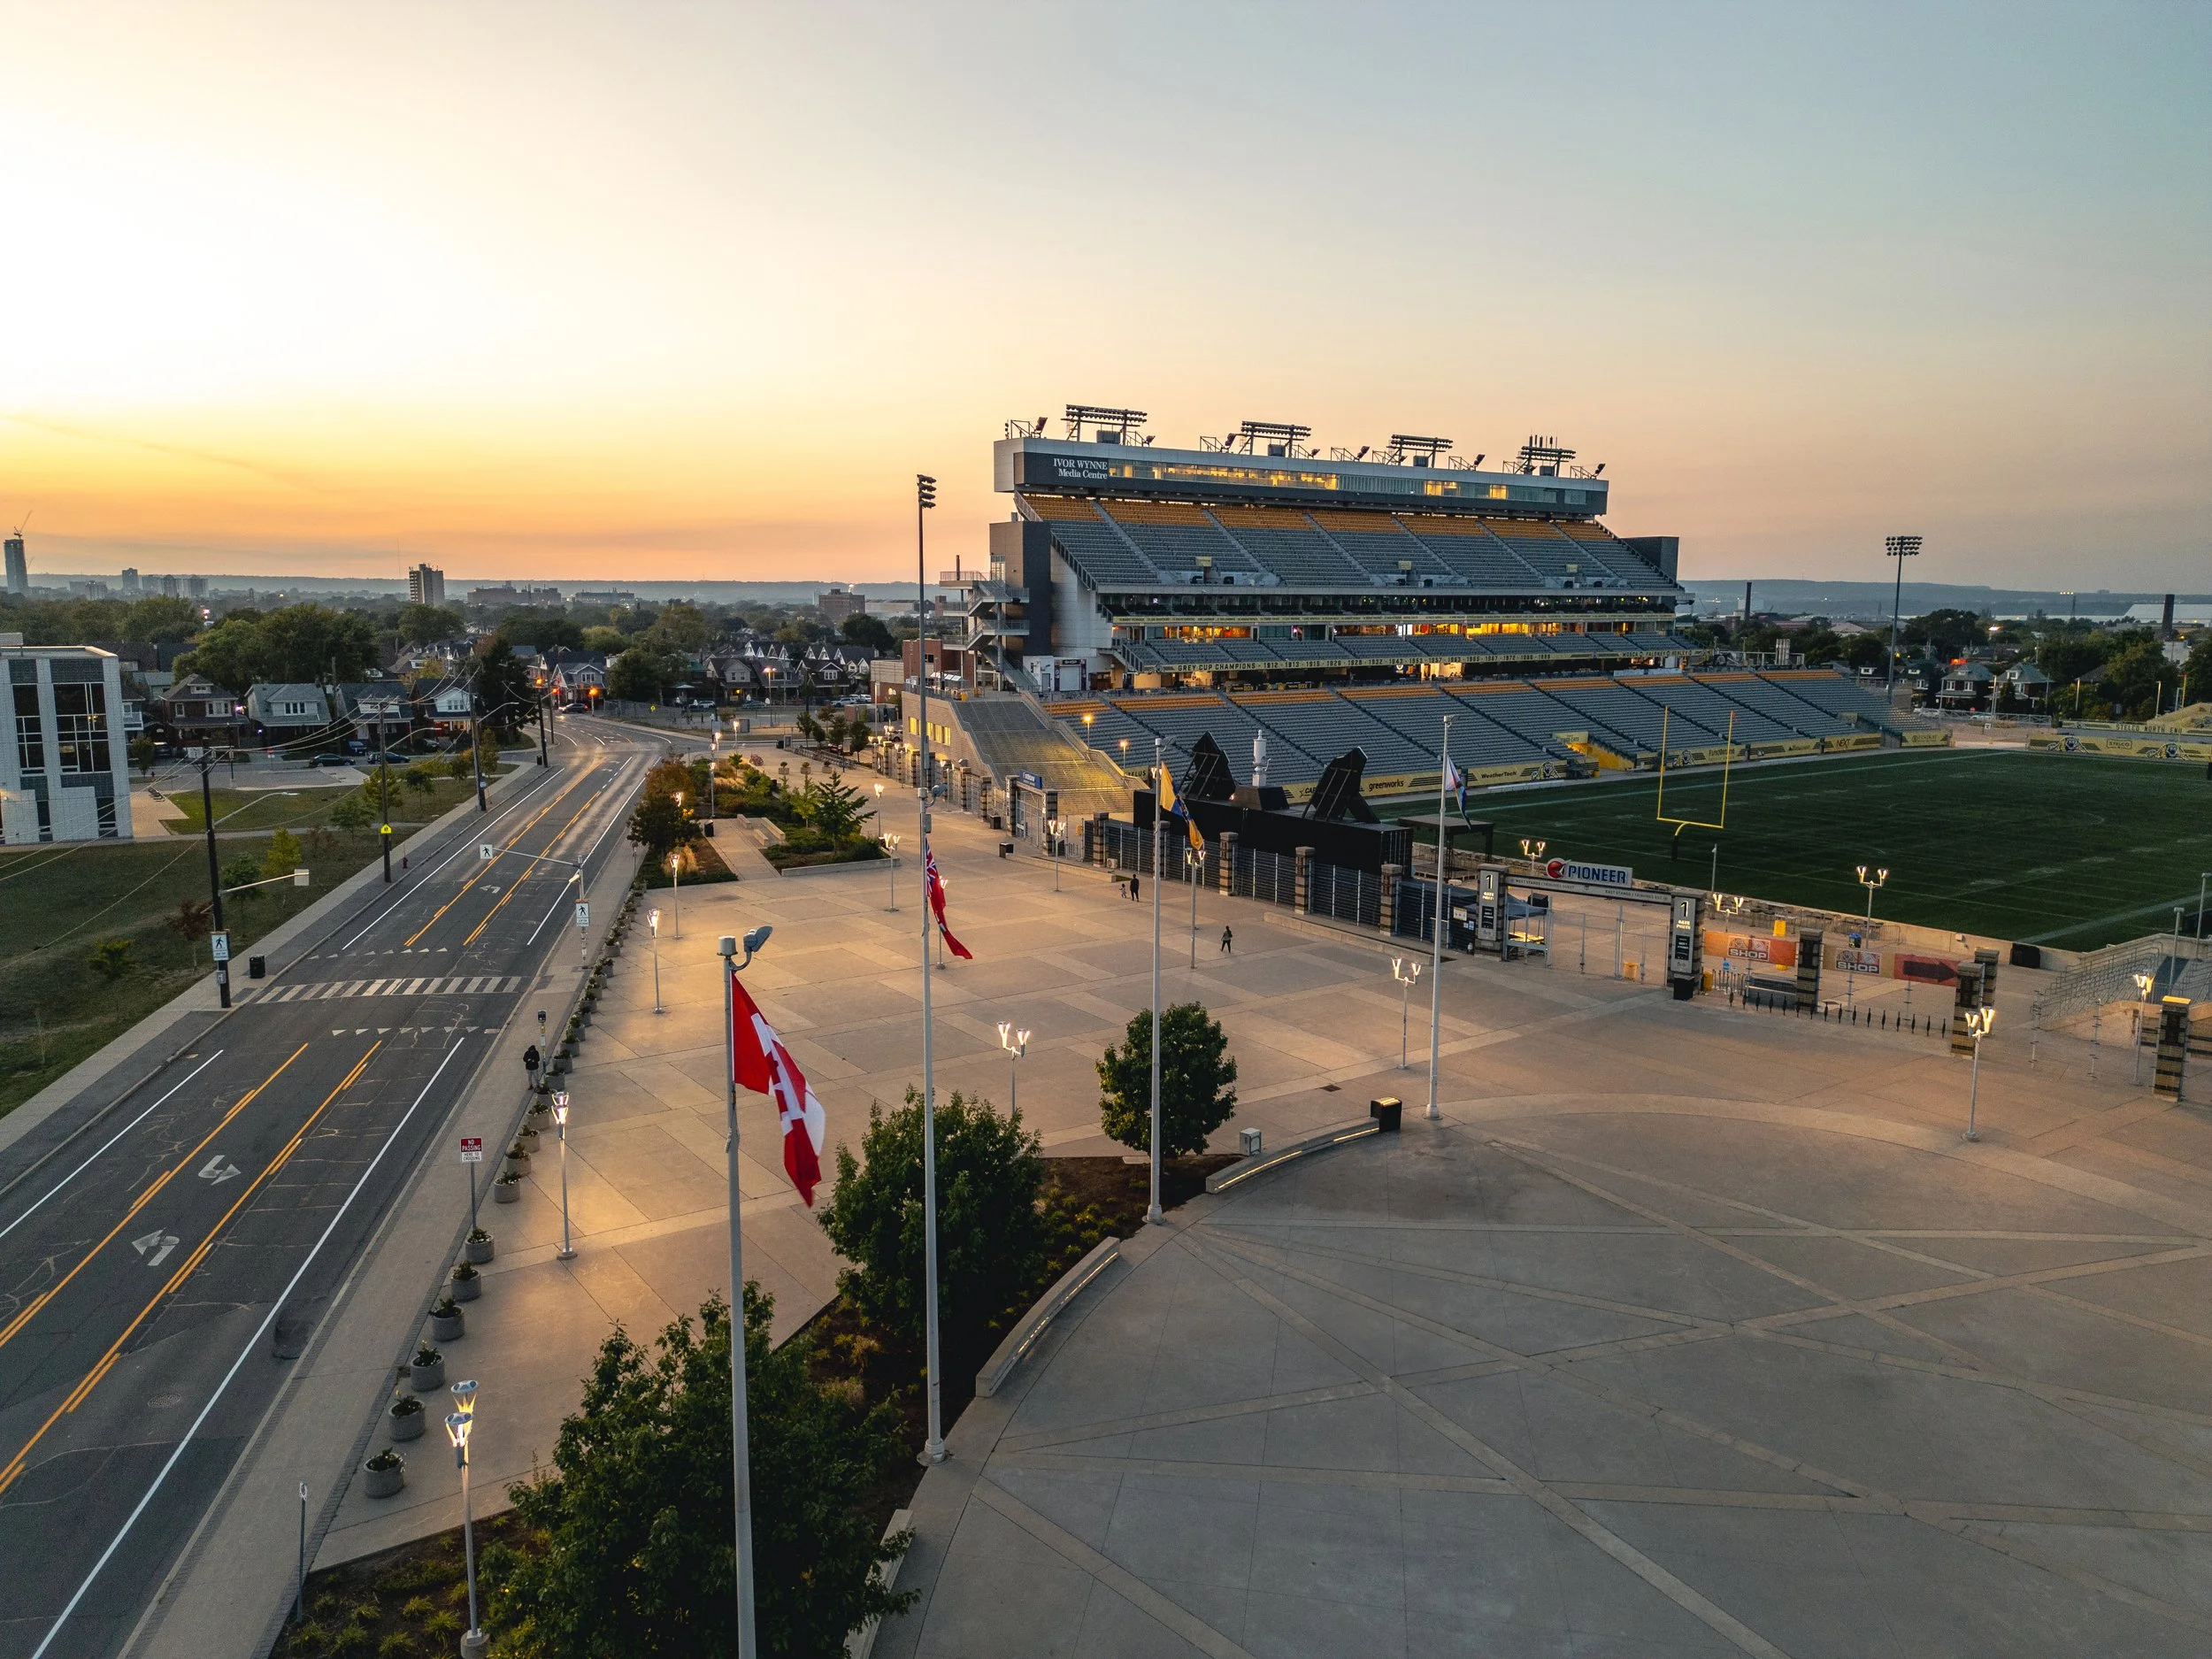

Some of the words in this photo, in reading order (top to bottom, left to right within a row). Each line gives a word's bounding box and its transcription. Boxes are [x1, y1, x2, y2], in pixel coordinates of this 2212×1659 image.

[1053, 457, 1075, 468] IVOR
[1077, 459, 1108, 470] WYNNE
[1058, 468, 1081, 478] Media
[1082, 469, 1108, 479] Centre
[1215, 662, 1256, 671] CHAMPIONS
[1480, 771, 1517, 780] WeatherTech
[1369, 779, 1404, 792] greenworks
[1568, 864, 1626, 884] PIONEER
[1486, 874, 1494, 889] 1
[1680, 901, 1689, 917] 1
[1730, 949, 1767, 960] SHOP
[1838, 962, 1878, 972] SHOP
